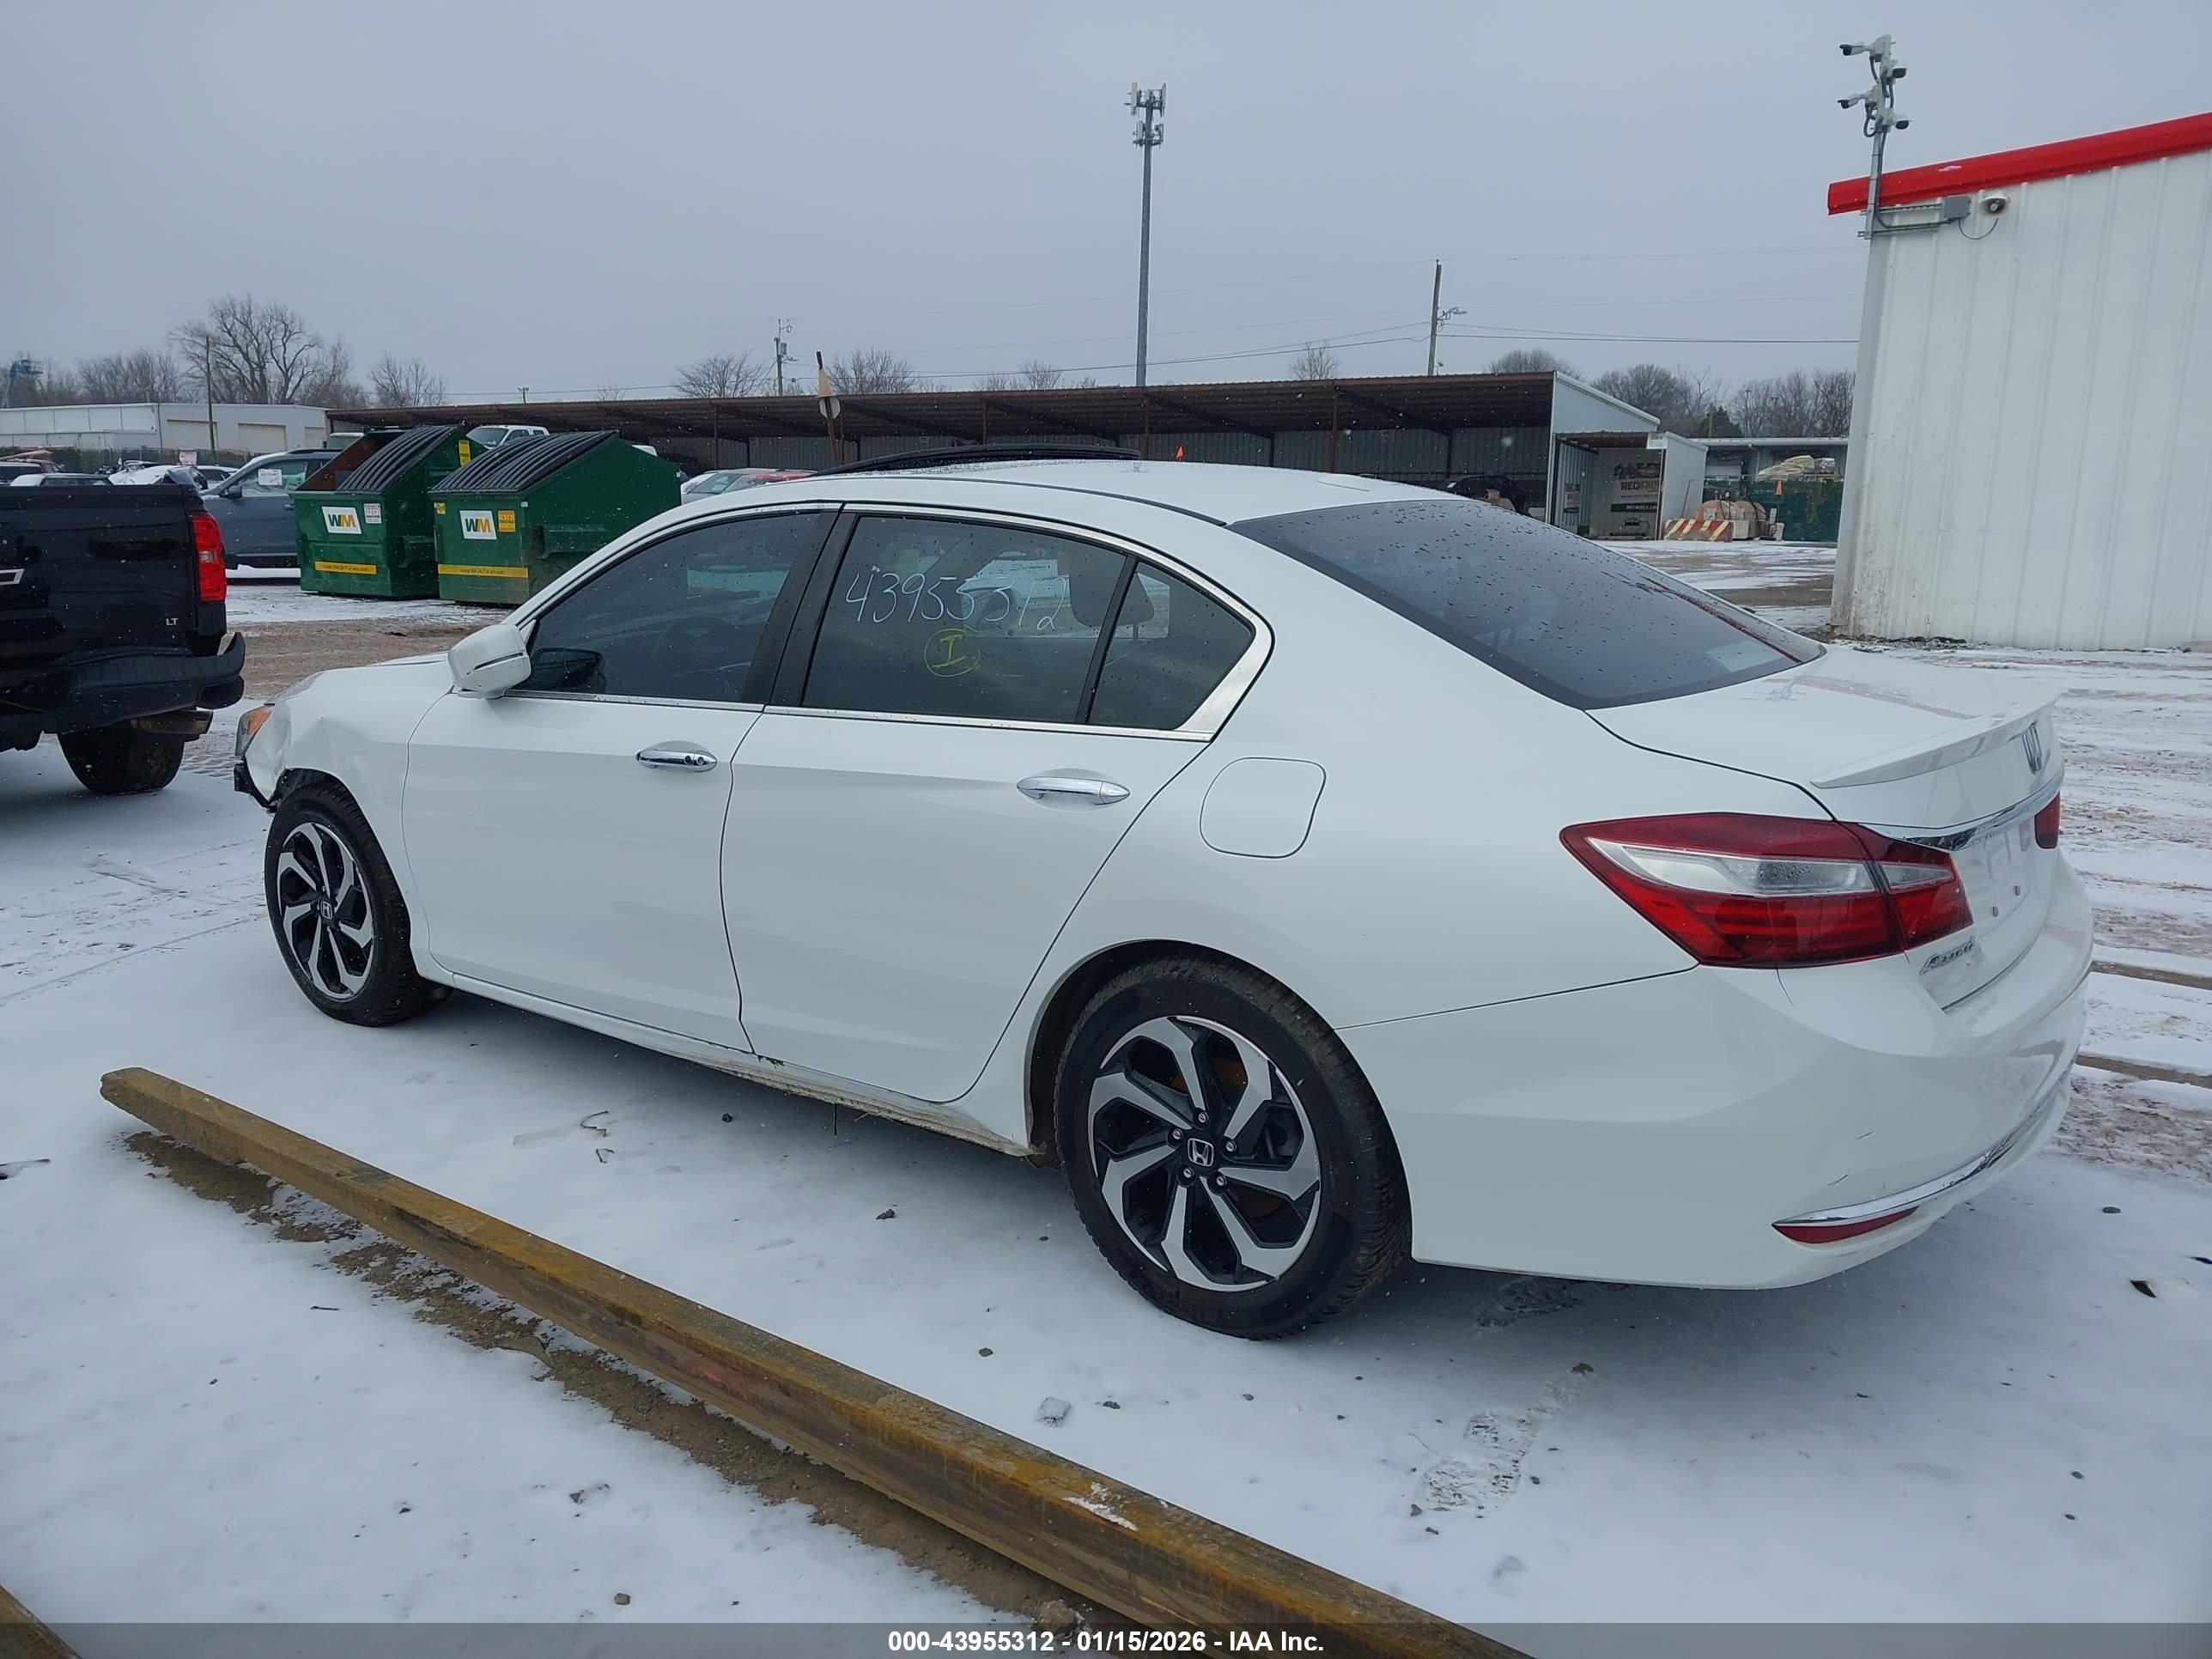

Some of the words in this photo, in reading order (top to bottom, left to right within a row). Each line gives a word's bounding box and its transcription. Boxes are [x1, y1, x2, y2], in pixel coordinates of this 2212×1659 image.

[327, 514, 356, 527] WM
[465, 518, 491, 532] WM
[846, 570, 1070, 631] 43955312
[166, 617, 179, 626] LT
